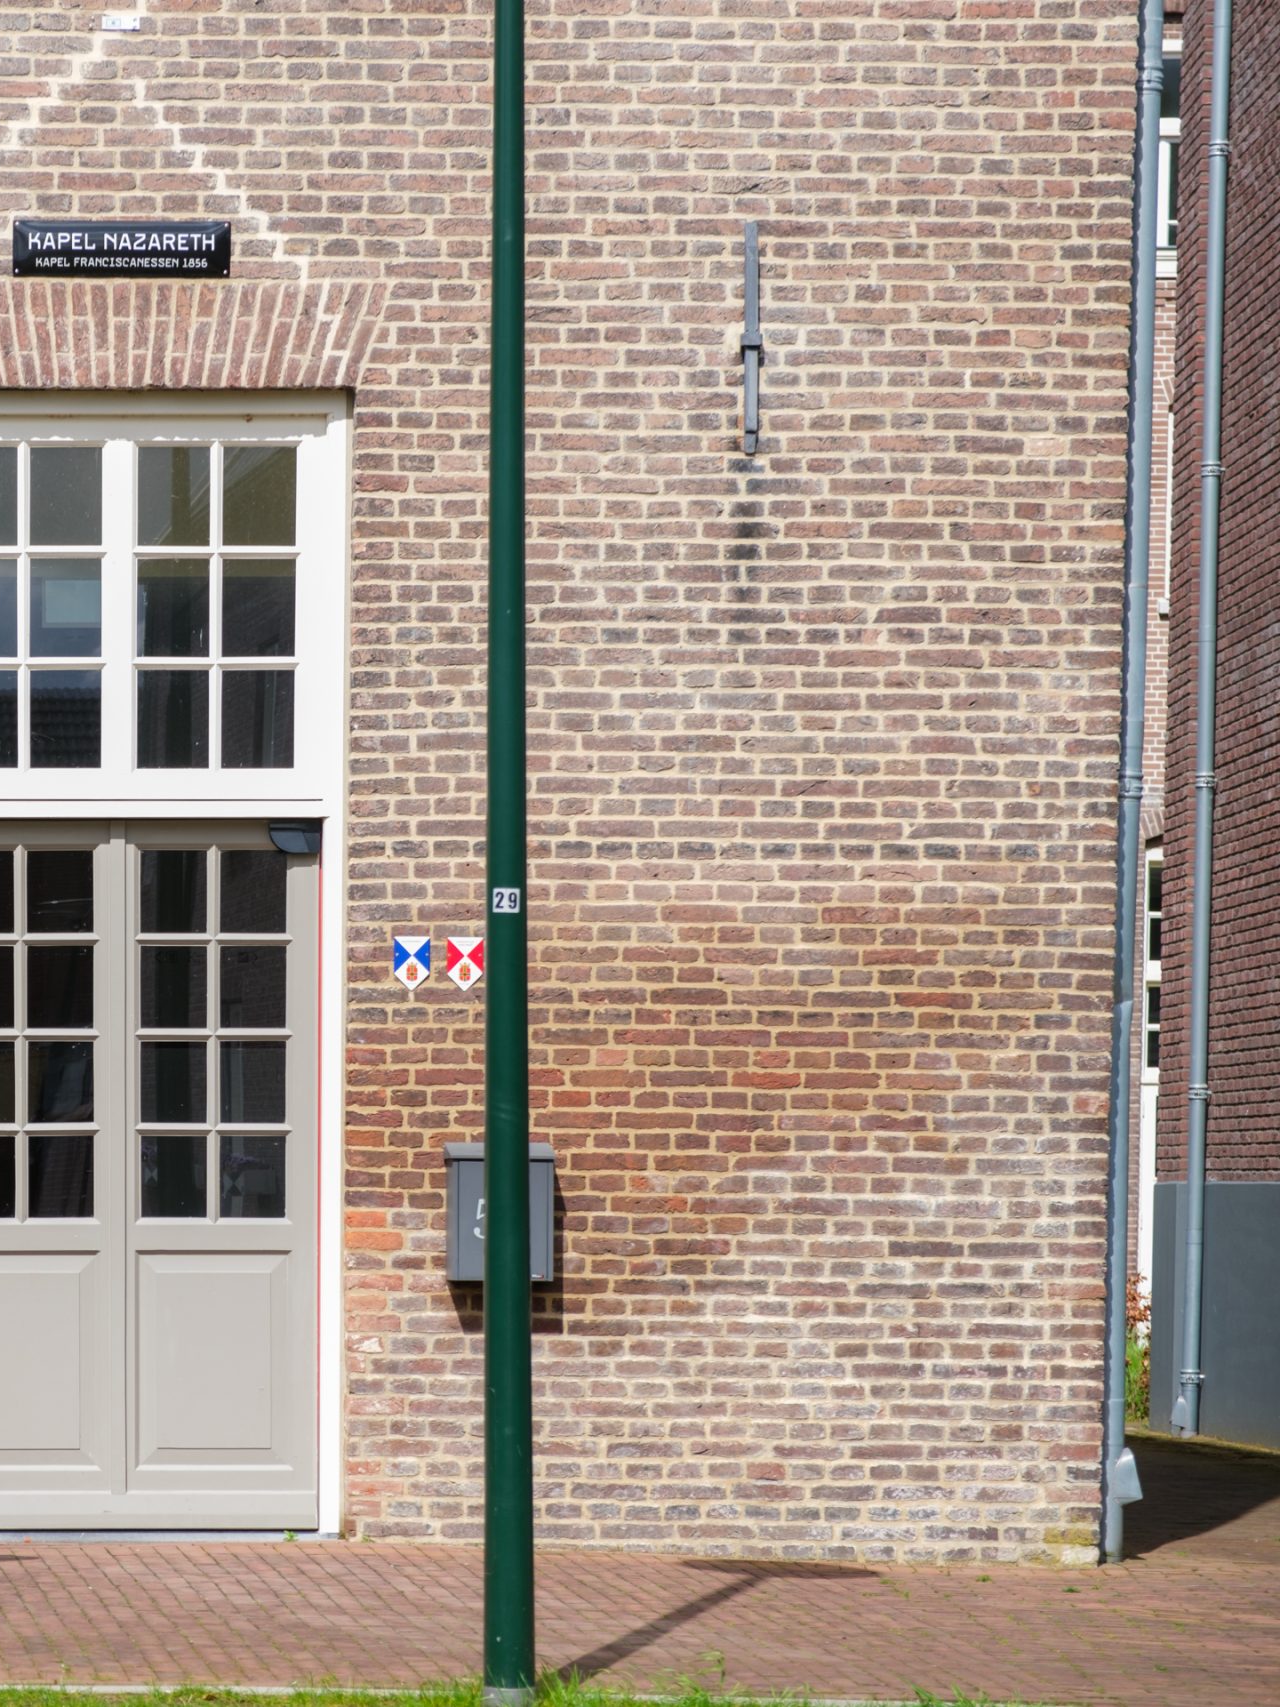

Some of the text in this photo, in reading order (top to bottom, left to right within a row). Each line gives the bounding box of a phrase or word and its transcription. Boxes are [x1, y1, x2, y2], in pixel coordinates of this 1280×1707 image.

[28, 232, 215, 251] KAPEL NAZARETH
[35, 257, 208, 268] KAPEL FRANCISCANESSEN 1856
[495, 891, 518, 909] 29
